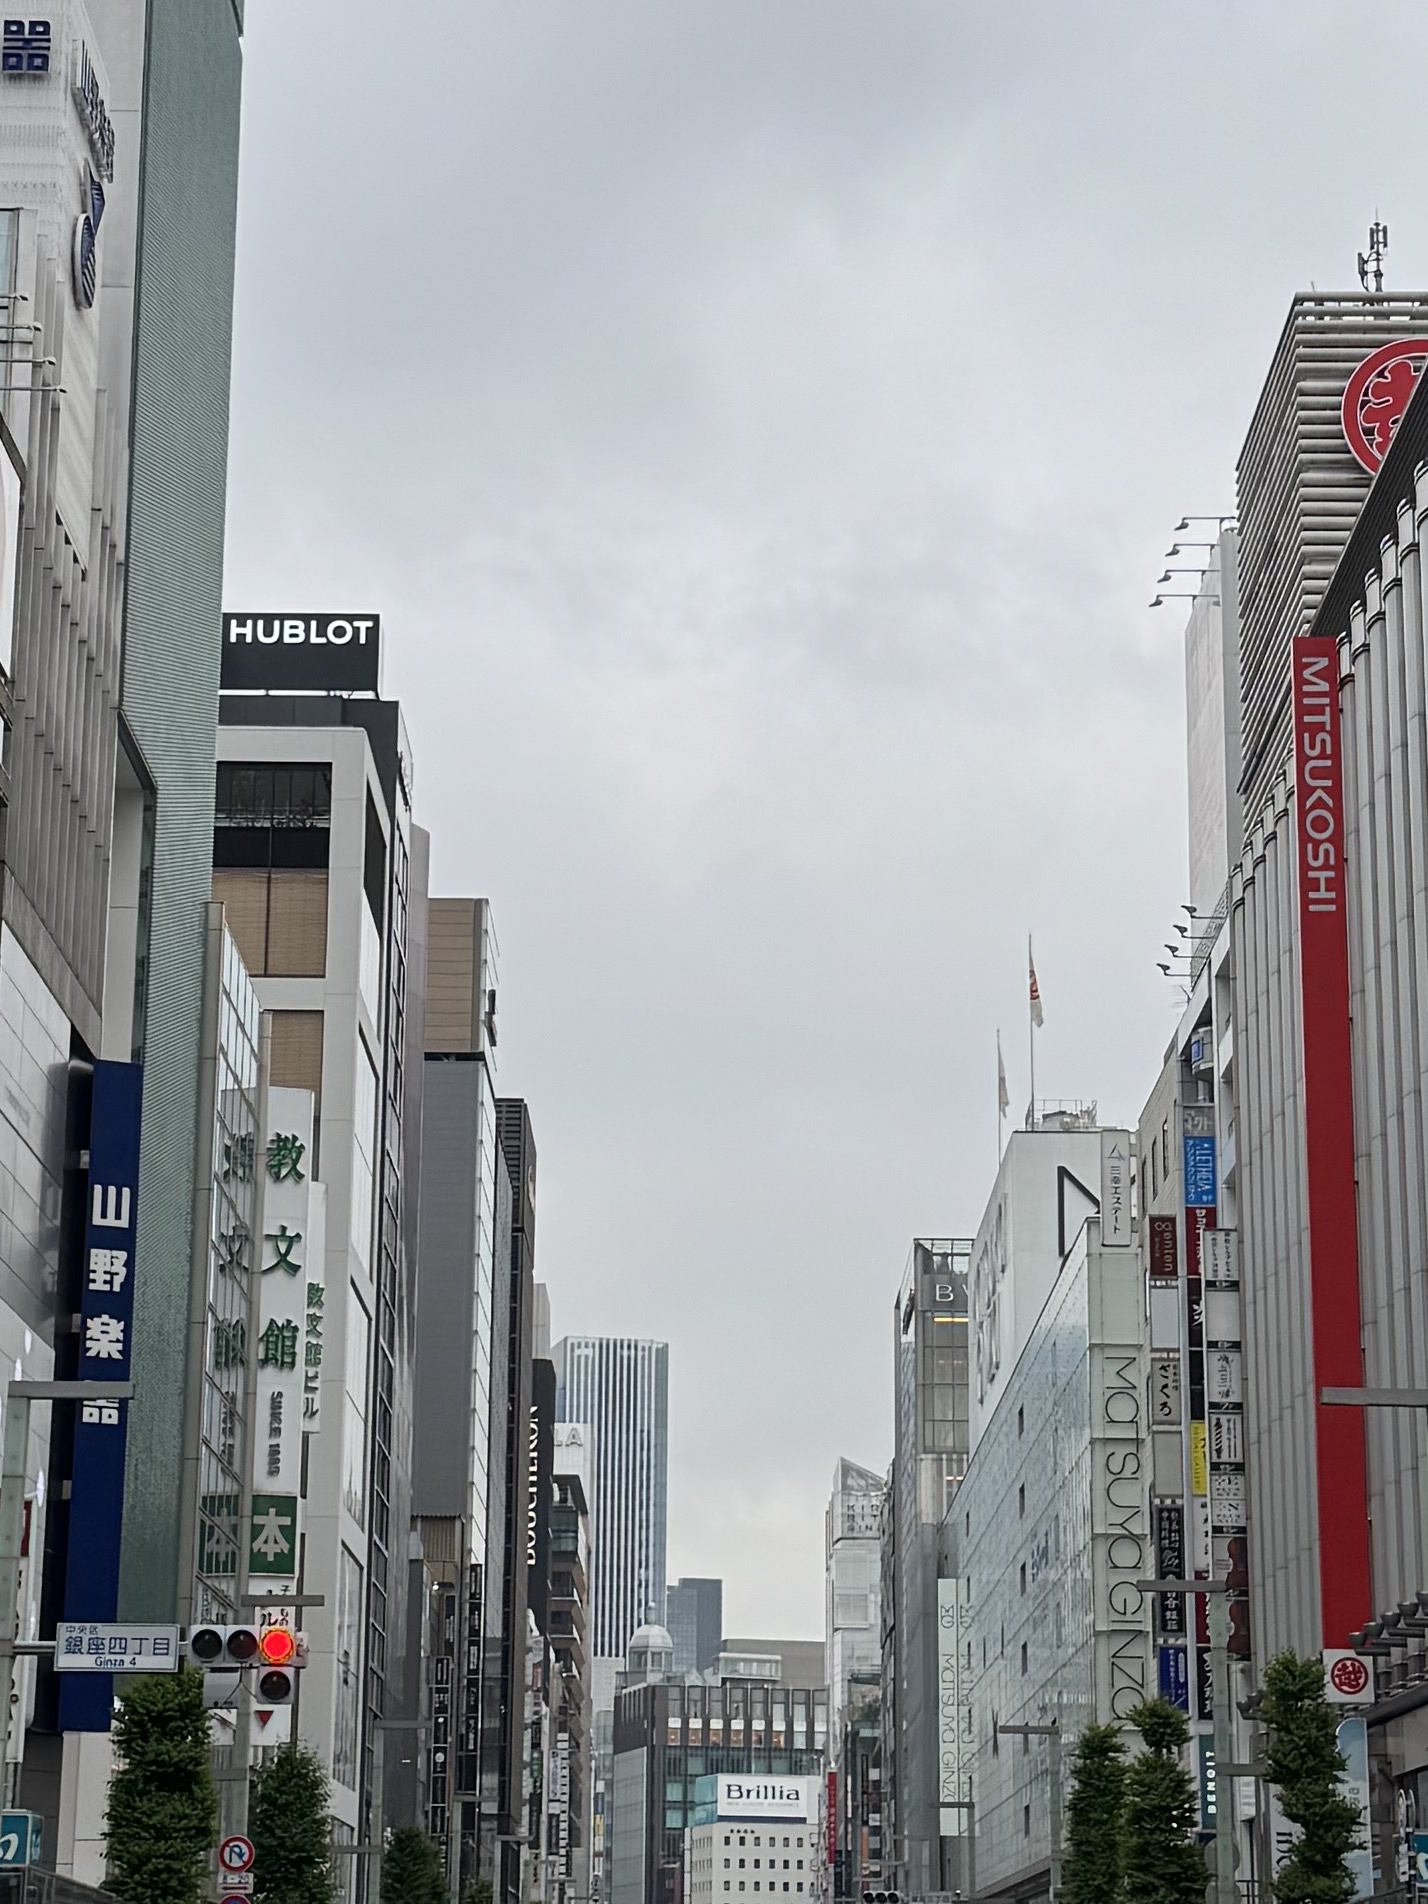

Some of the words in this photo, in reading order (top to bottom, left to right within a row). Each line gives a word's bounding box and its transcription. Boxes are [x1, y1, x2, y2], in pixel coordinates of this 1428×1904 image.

[229, 618, 374, 645] HUBLOT
[1301, 656, 1337, 912] MITSUKOSHI
[258, 1131, 307, 1372] 教文館
[252, 1507, 292, 1562] 本
[65, 1625, 99, 1636] 中央区
[63, 1635, 170, 1656] 銀座四丁目
[94, 1656, 125, 1668] Ginza
[129, 1656, 137, 1667] 4
[726, 1784, 800, 1801] Brillia
[1205, 1751, 1217, 1814] BENOIT
